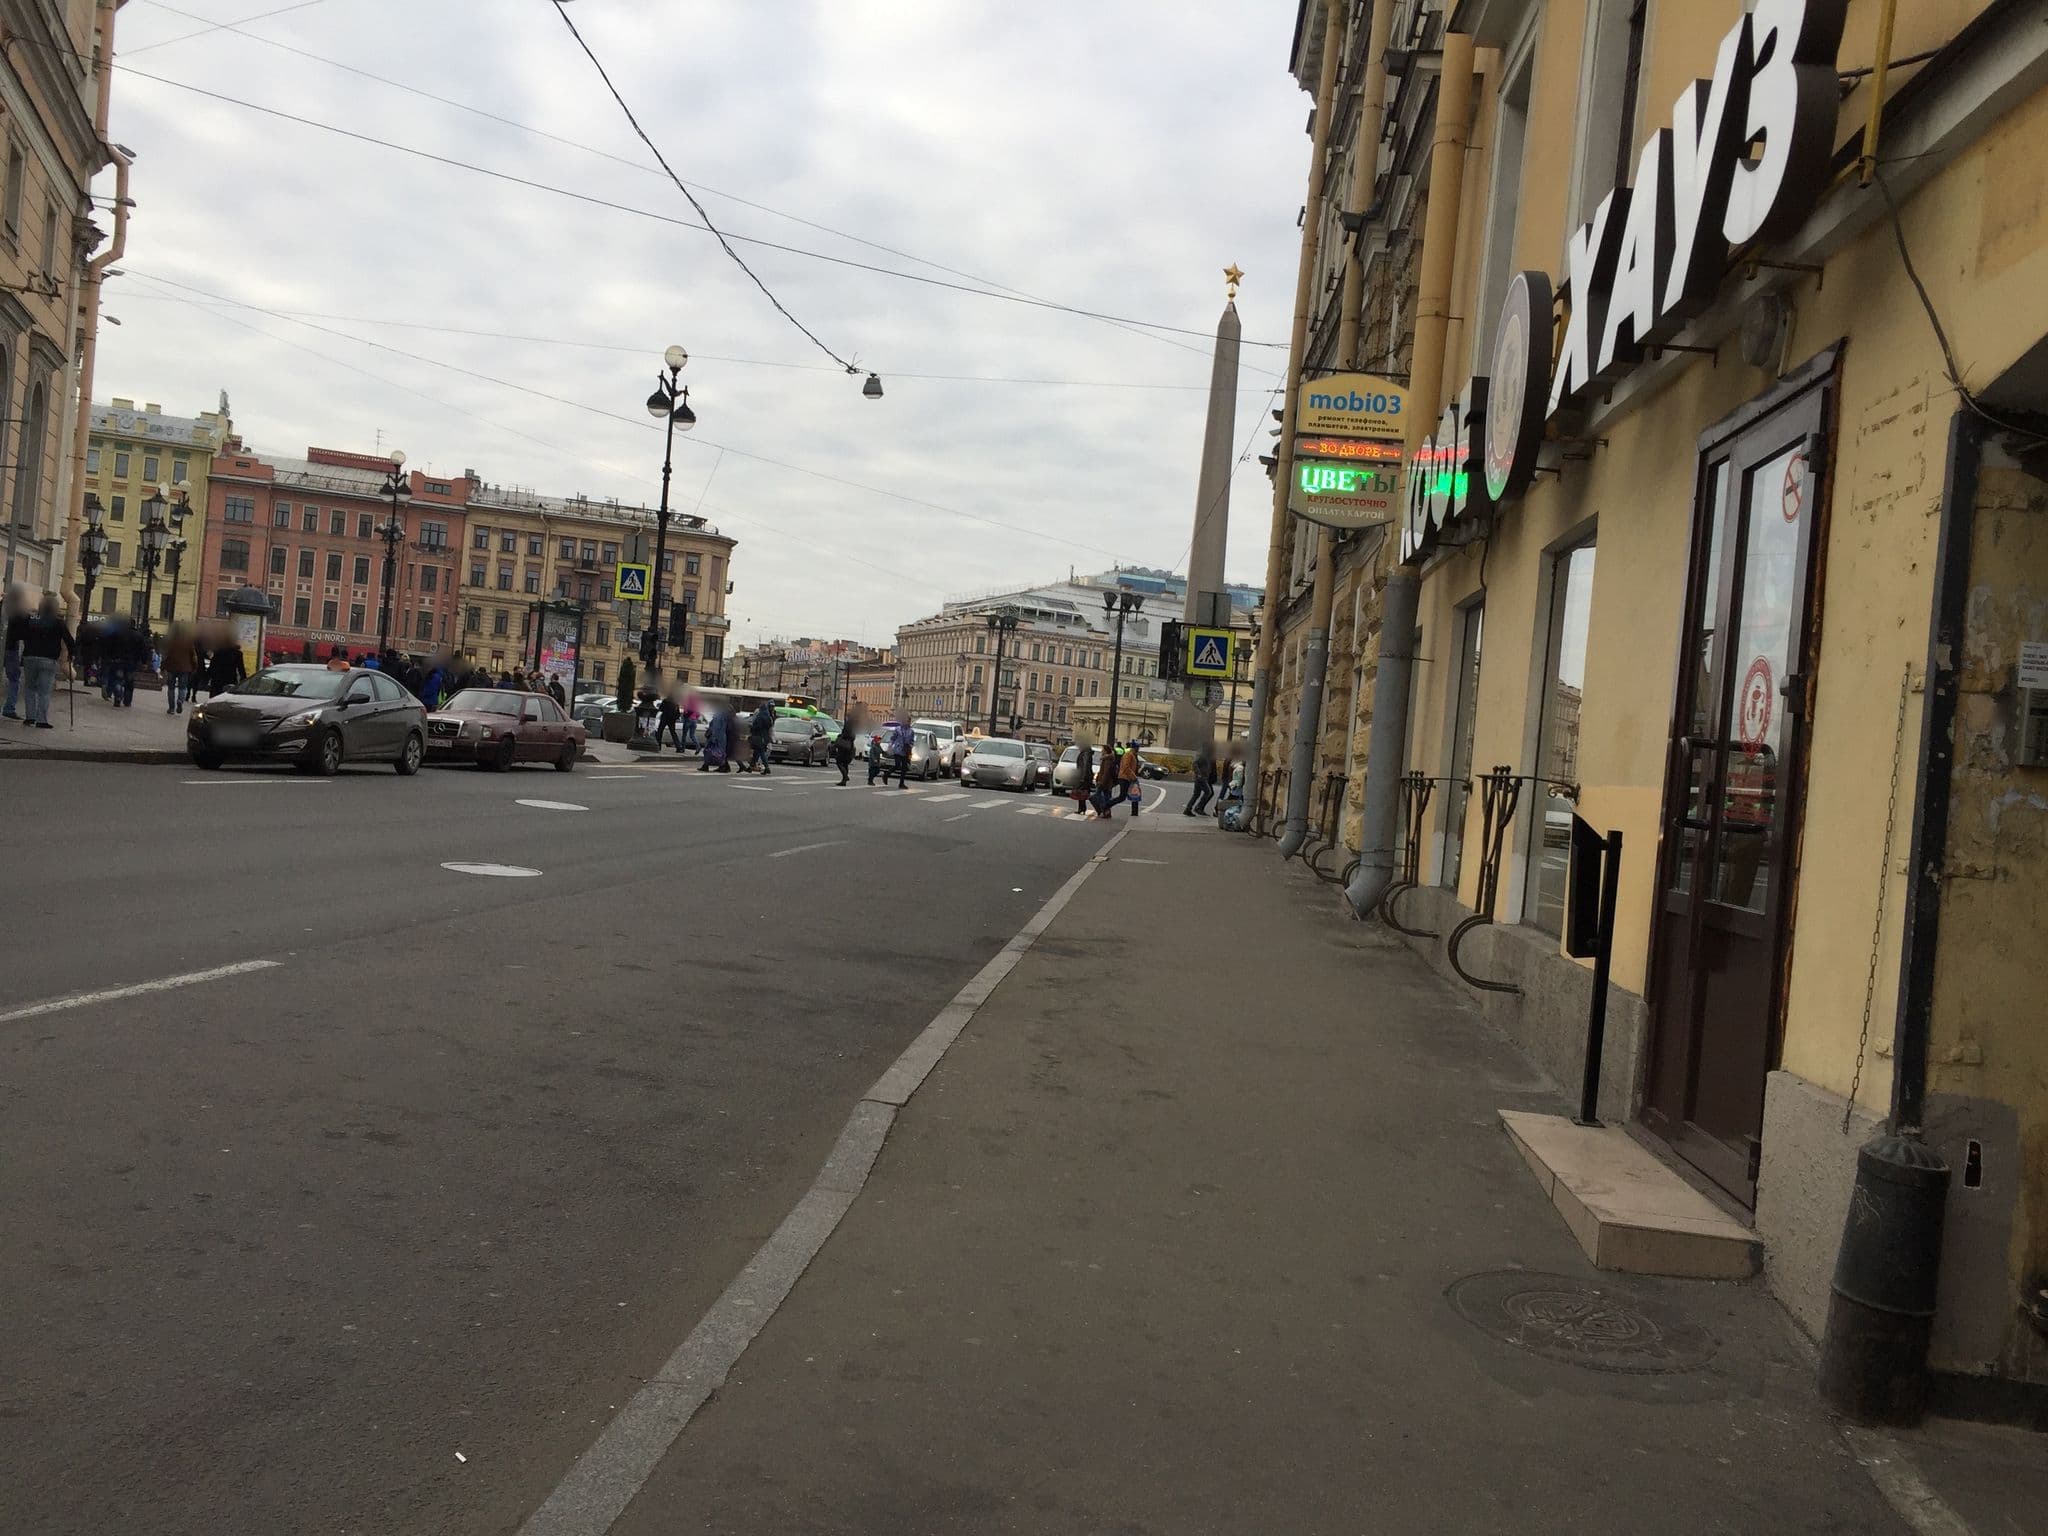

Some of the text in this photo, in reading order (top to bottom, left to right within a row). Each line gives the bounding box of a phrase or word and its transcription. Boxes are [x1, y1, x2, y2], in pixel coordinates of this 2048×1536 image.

[1545, 0, 1807, 420] ХАУЗ
[1309, 390, 1402, 415] mobi03
[1351, 425, 1400, 434] электроники
[1339, 444, 1381, 458] ДВОРЕ
[1301, 466, 1398, 494] ЦВЕТЫ
[1307, 495, 1388, 509] КРУГЛОСУТОЧНО
[1308, 506, 1385, 520] ОПЛАТА КАРТОЙ
[324, 633, 346, 643] NORD
